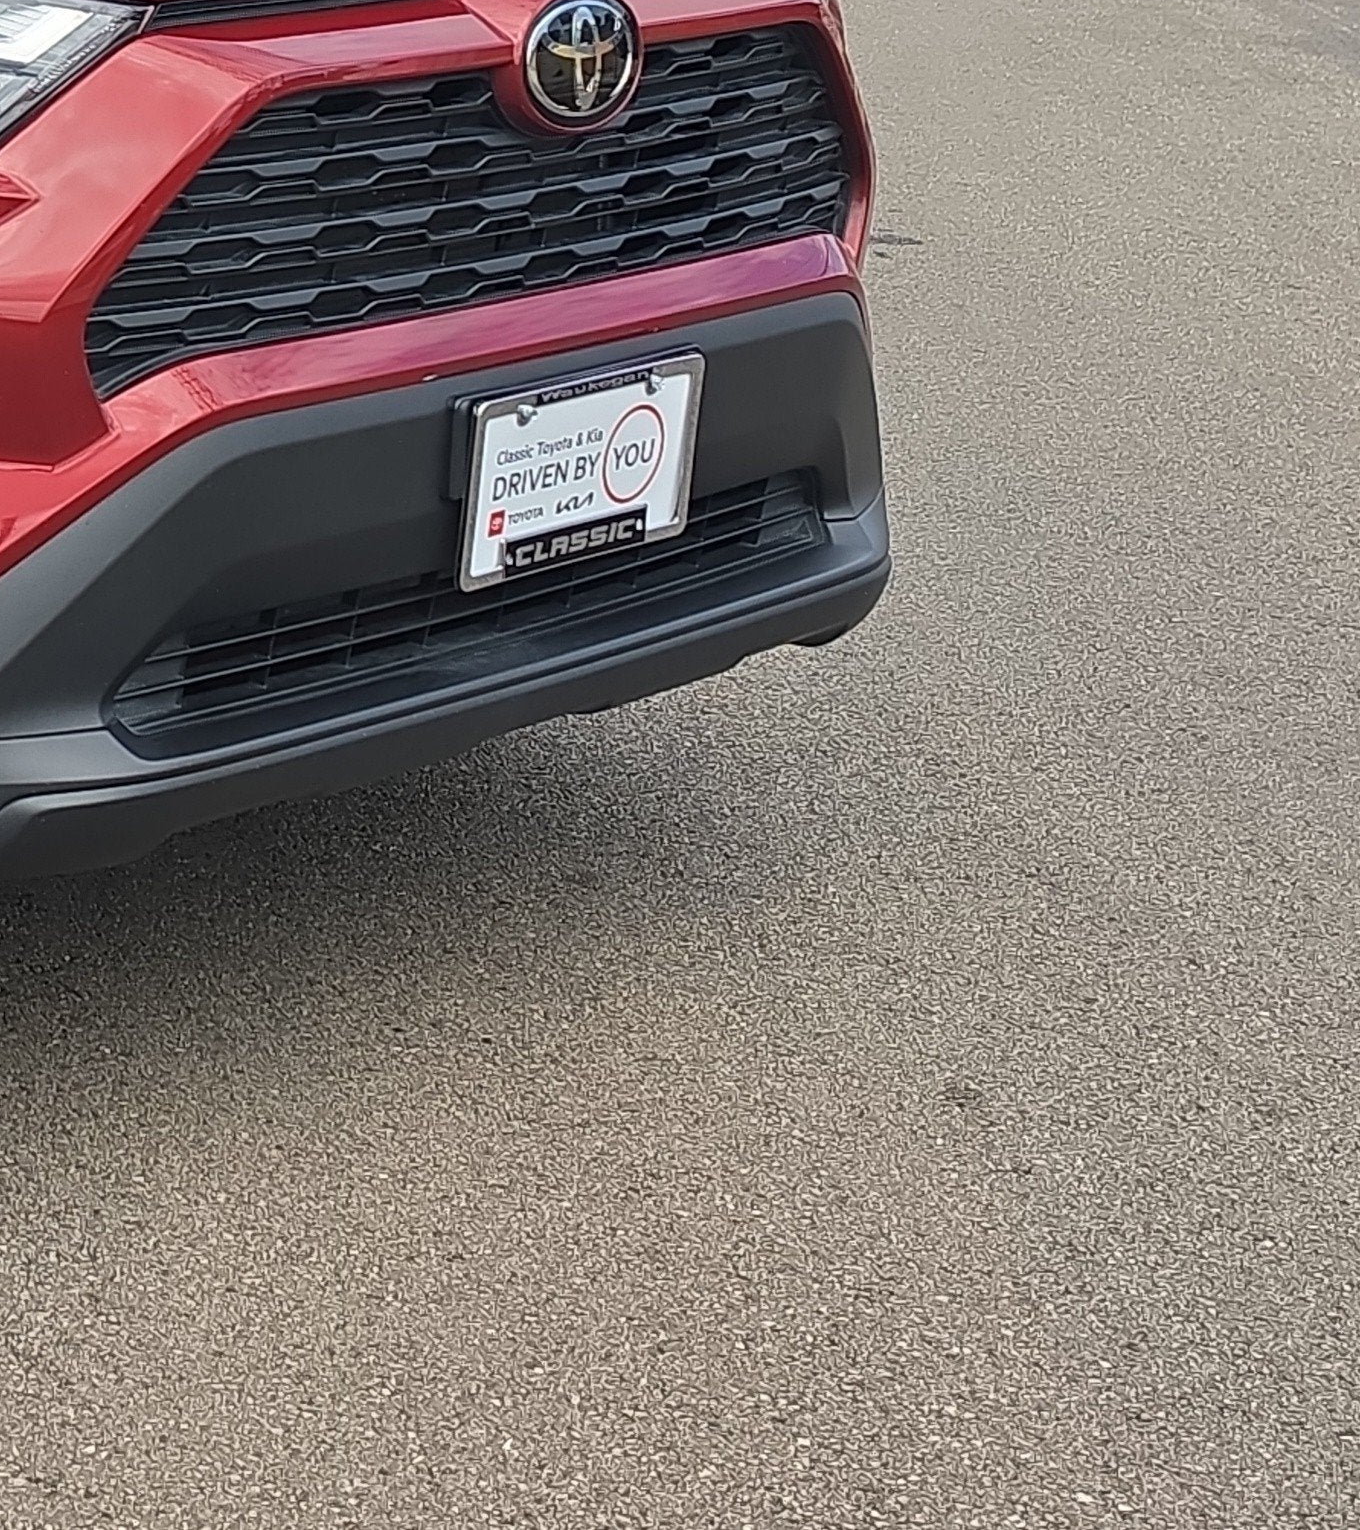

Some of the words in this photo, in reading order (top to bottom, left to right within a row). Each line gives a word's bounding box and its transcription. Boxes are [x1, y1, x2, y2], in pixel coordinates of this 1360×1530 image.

[542, 371, 650, 403] Waukegan
[497, 443, 535, 466] Classic
[537, 435, 573, 457] Toyota
[576, 432, 584, 447] &
[587, 427, 604, 443] Kia
[492, 459, 570, 501] DRIVEN
[574, 451, 601, 481] BY
[613, 438, 655, 471] YOU
[508, 506, 544, 525] TOYOTA
[515, 518, 636, 567] CLASSIC
